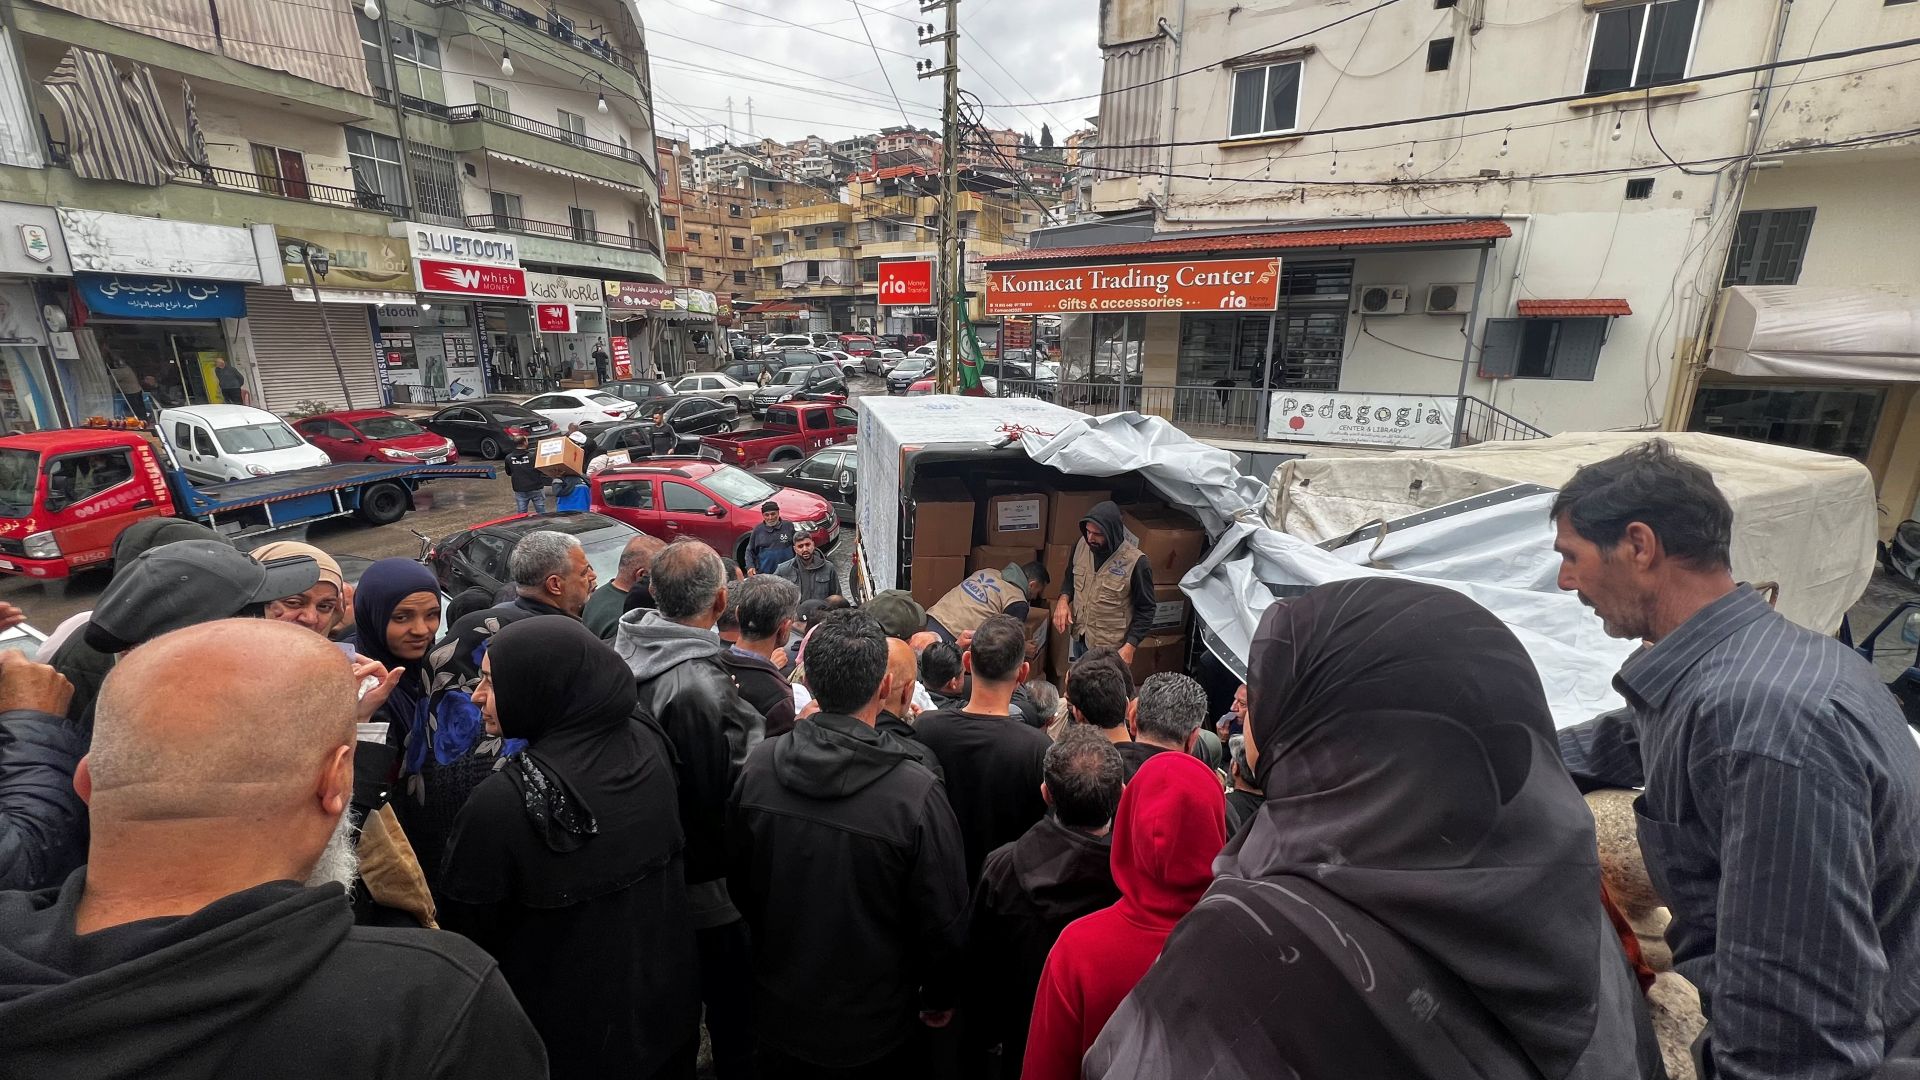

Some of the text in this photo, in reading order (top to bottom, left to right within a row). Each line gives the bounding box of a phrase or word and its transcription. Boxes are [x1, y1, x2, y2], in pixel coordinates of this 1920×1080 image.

[417, 231, 514, 260] BLUETOOTH
[482, 272, 515, 284] whish
[483, 281, 510, 291] MONEY
[881, 274, 906, 294] ria
[1001, 266, 1255, 294] Komacat Trading Center
[187, 284, 219, 301] بن
[1220, 290, 1247, 308] ria
[1058, 294, 1183, 310] Gifts & accessories
[1282, 397, 1443, 428] Pedagogia
[1338, 424, 1365, 432] CENTER
[1372, 426, 1403, 434] LIBRARY
[73, 551, 106, 563] FUSO
